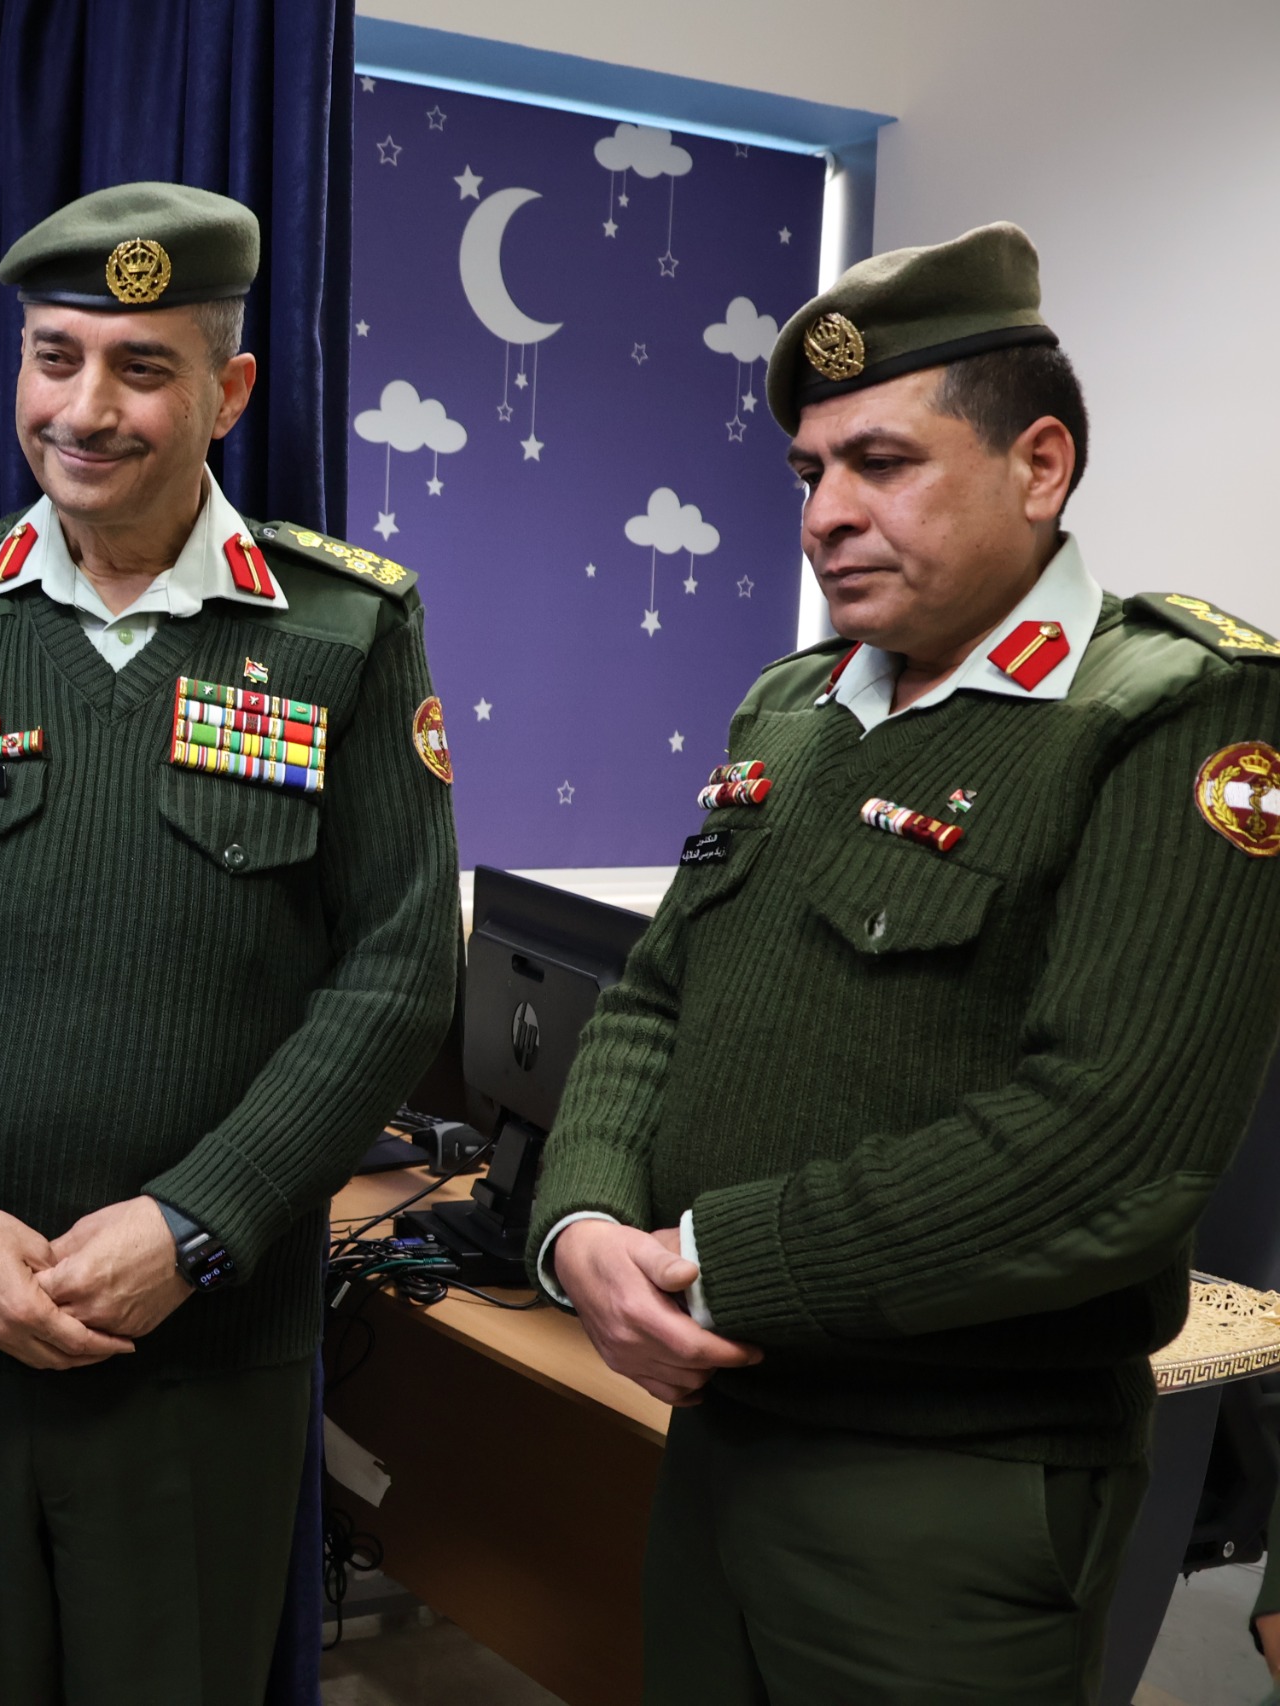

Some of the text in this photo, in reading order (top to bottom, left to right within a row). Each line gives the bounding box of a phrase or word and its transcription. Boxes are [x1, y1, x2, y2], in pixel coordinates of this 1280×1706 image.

[696, 834, 718, 847] الدكتور
[513, 1002, 539, 1072] hp
[200, 1267, 221, 1284] 9:40
